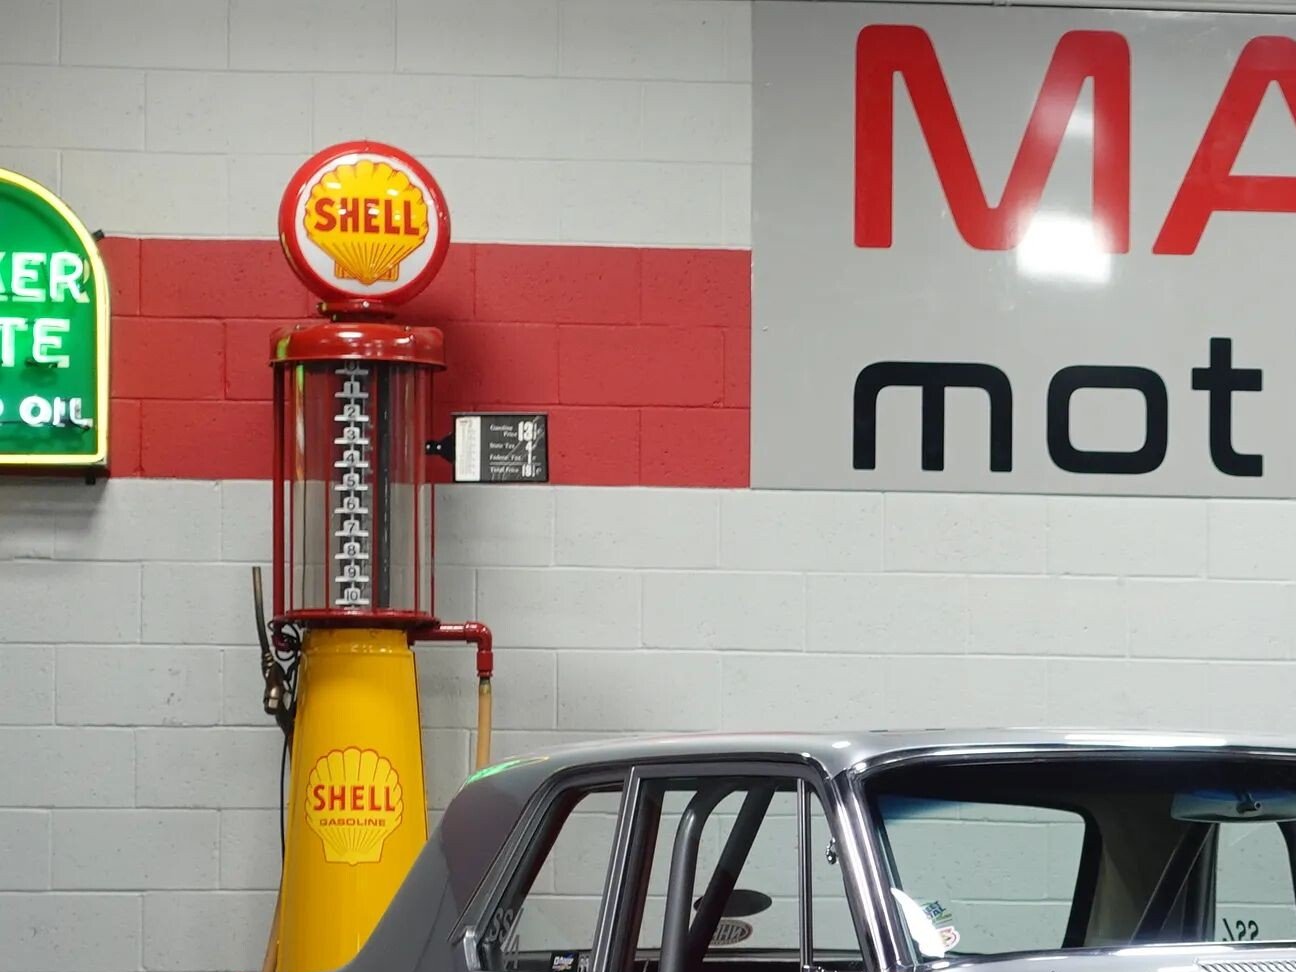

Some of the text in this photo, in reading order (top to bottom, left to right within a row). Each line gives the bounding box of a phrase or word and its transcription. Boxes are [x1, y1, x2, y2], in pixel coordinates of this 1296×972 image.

[314, 198, 420, 236] SHELL
[0, 251, 90, 303] ER
[19, 395, 93, 427] OIL
[346, 406, 356, 418] 2
[346, 429, 356, 440] 3
[346, 453, 356, 464] 4
[346, 476, 356, 487] 5
[346, 499, 356, 510] 6
[347, 522, 356, 533] 7
[346, 545, 357, 556] 8
[346, 567, 357, 578] 9
[346, 590, 358, 601] 10
[313, 783, 396, 812] SHELL
[319, 817, 386, 827] GASOLINE
